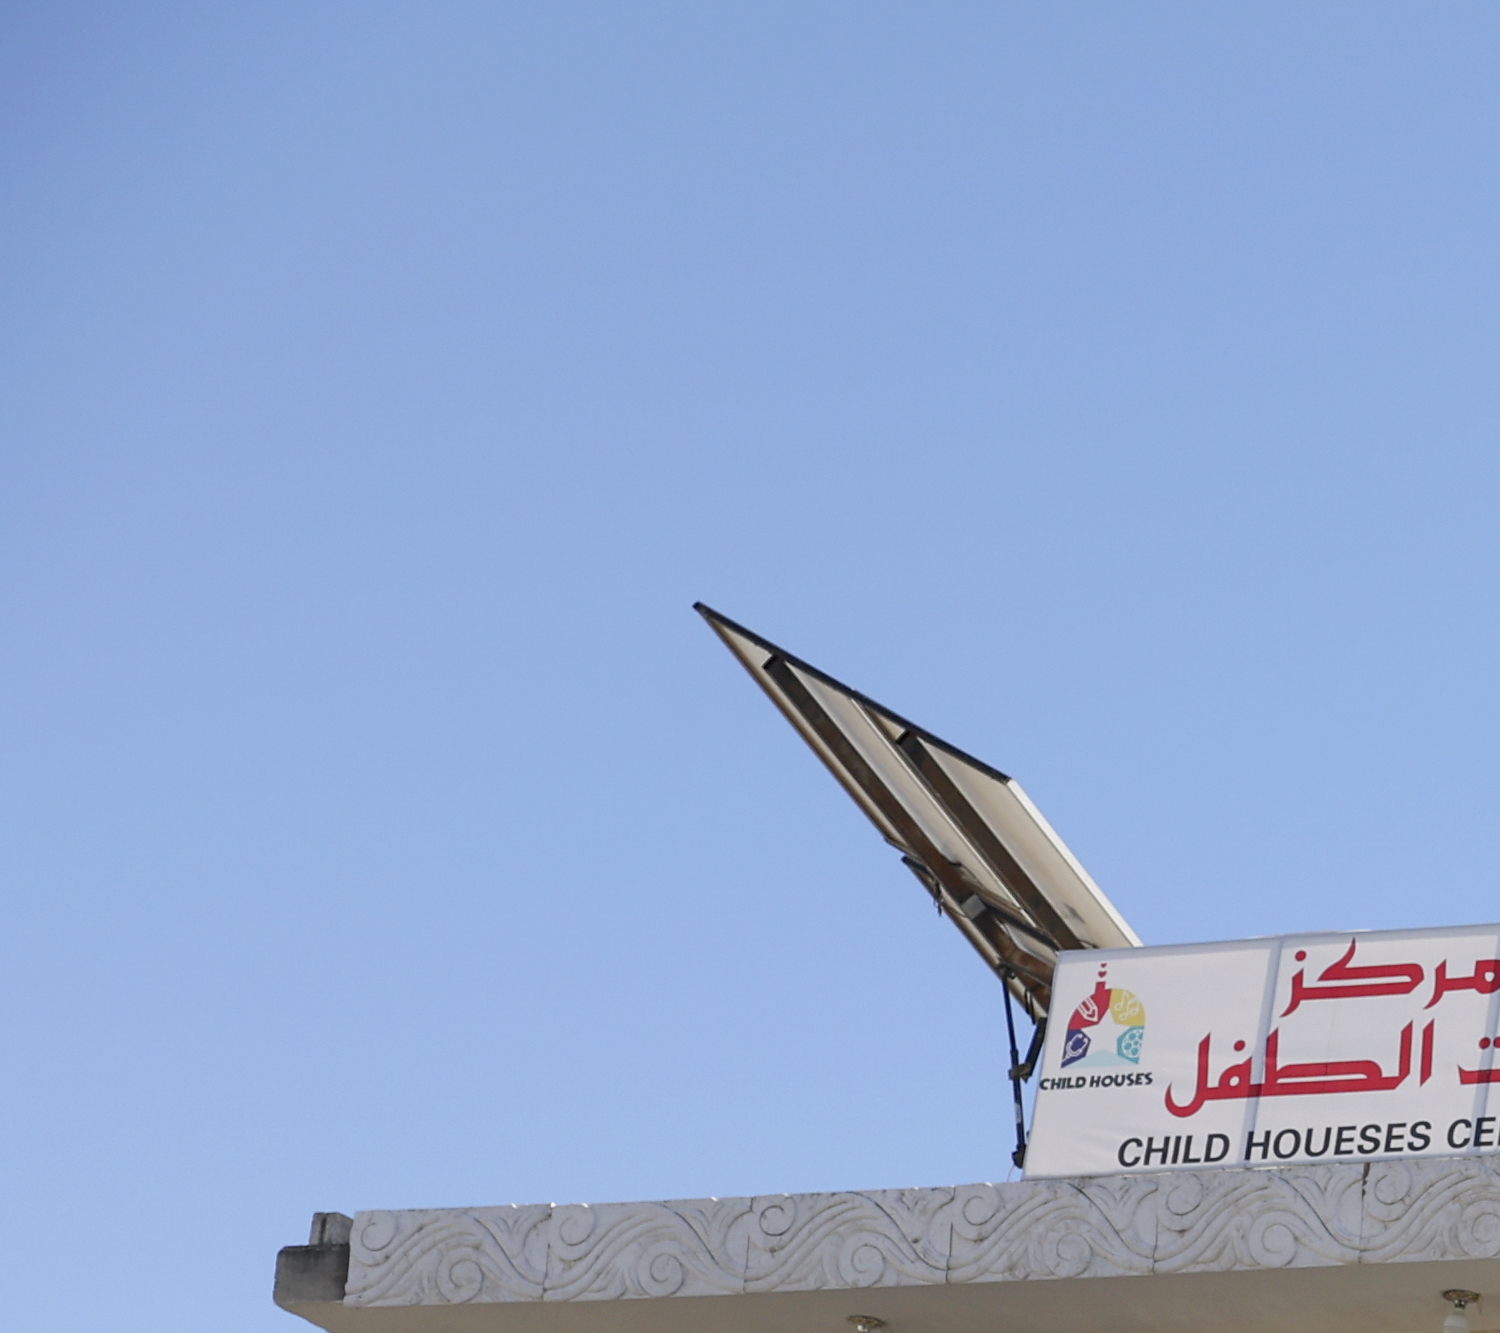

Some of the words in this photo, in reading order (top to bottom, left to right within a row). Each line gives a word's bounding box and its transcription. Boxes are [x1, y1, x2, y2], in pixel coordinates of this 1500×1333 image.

[1039, 1074, 1087, 1091] CHILD
[1089, 1072, 1153, 1088] HOUSES
[1165, 1019, 1434, 1118] الطفل
[1118, 1133, 1230, 1168] CHILD
[1244, 1121, 1432, 1161] HOUESES
